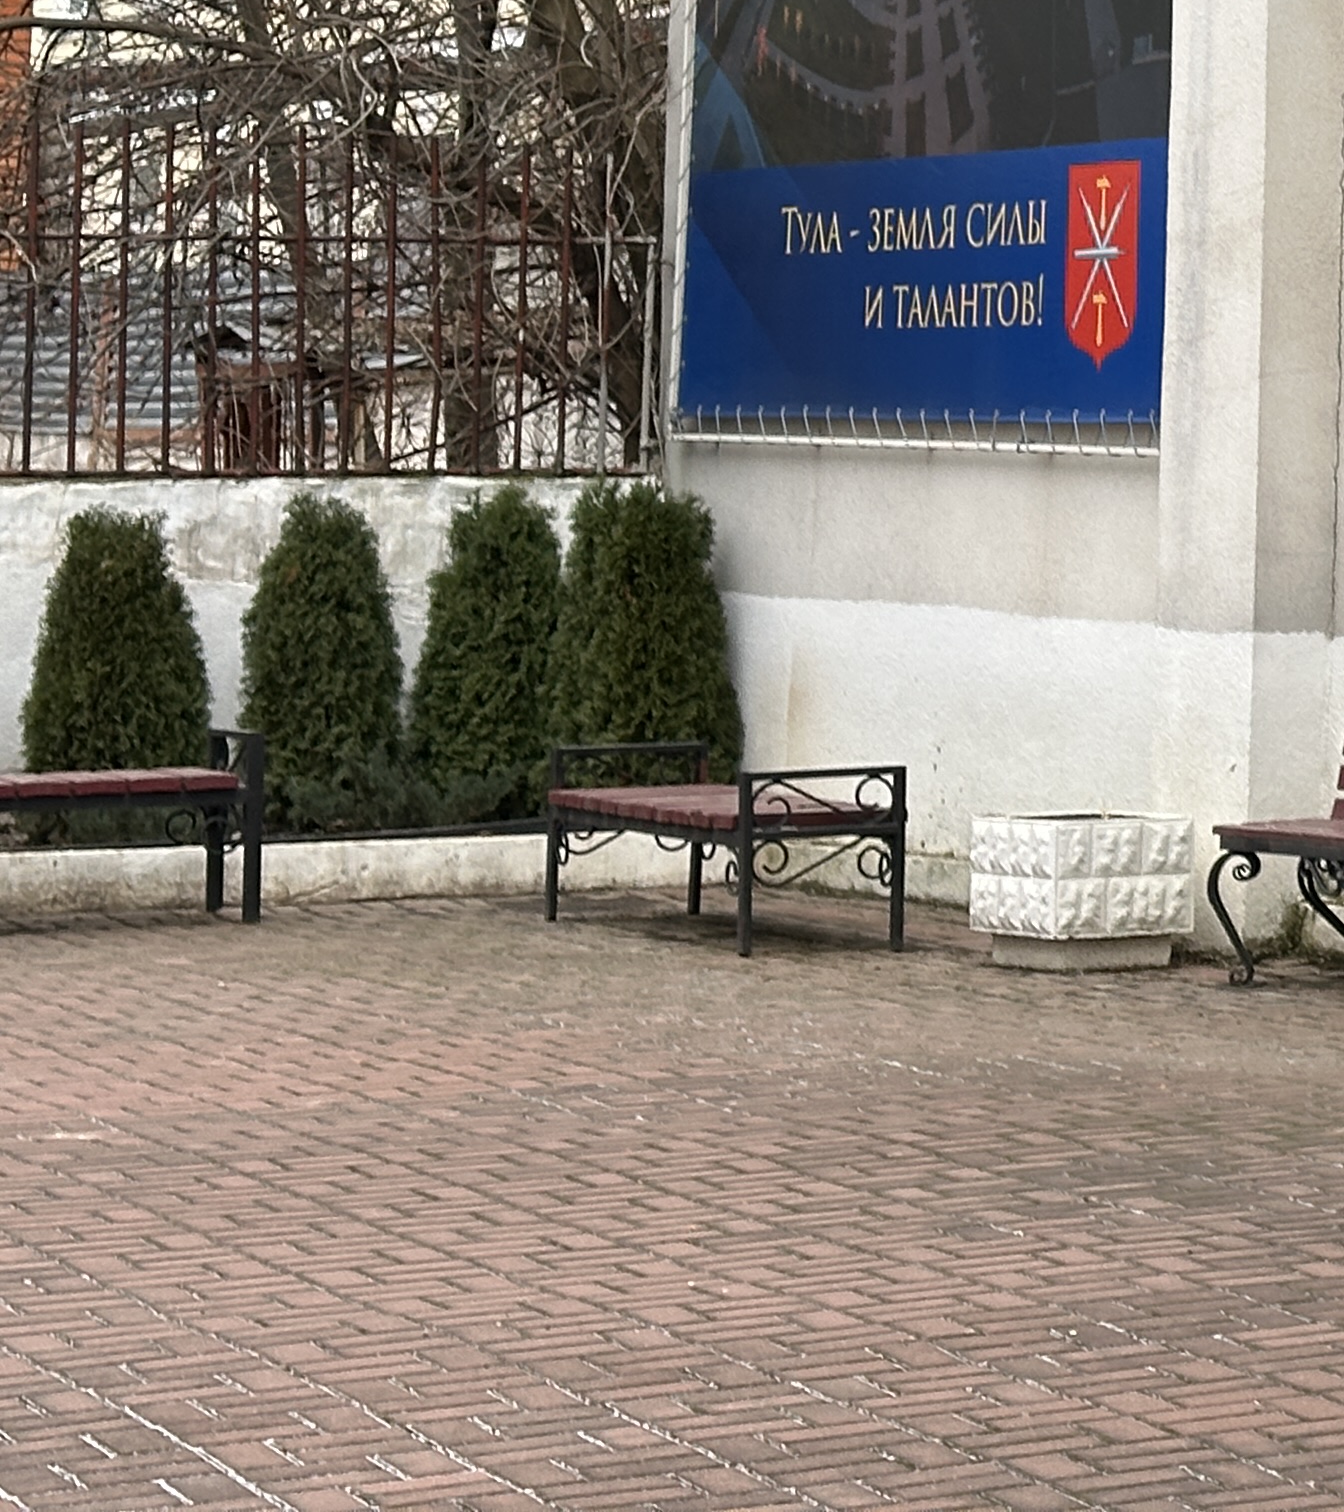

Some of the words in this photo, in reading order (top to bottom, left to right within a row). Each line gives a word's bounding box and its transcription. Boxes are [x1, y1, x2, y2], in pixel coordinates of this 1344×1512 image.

[781, 205, 843, 256] ТУЛА
[867, 203, 956, 254] ЗЕМЛЯ
[965, 199, 1047, 248] СИЛЫ
[863, 285, 884, 330] И
[893, 273, 1044, 330] ТАЛАНТОВ!
